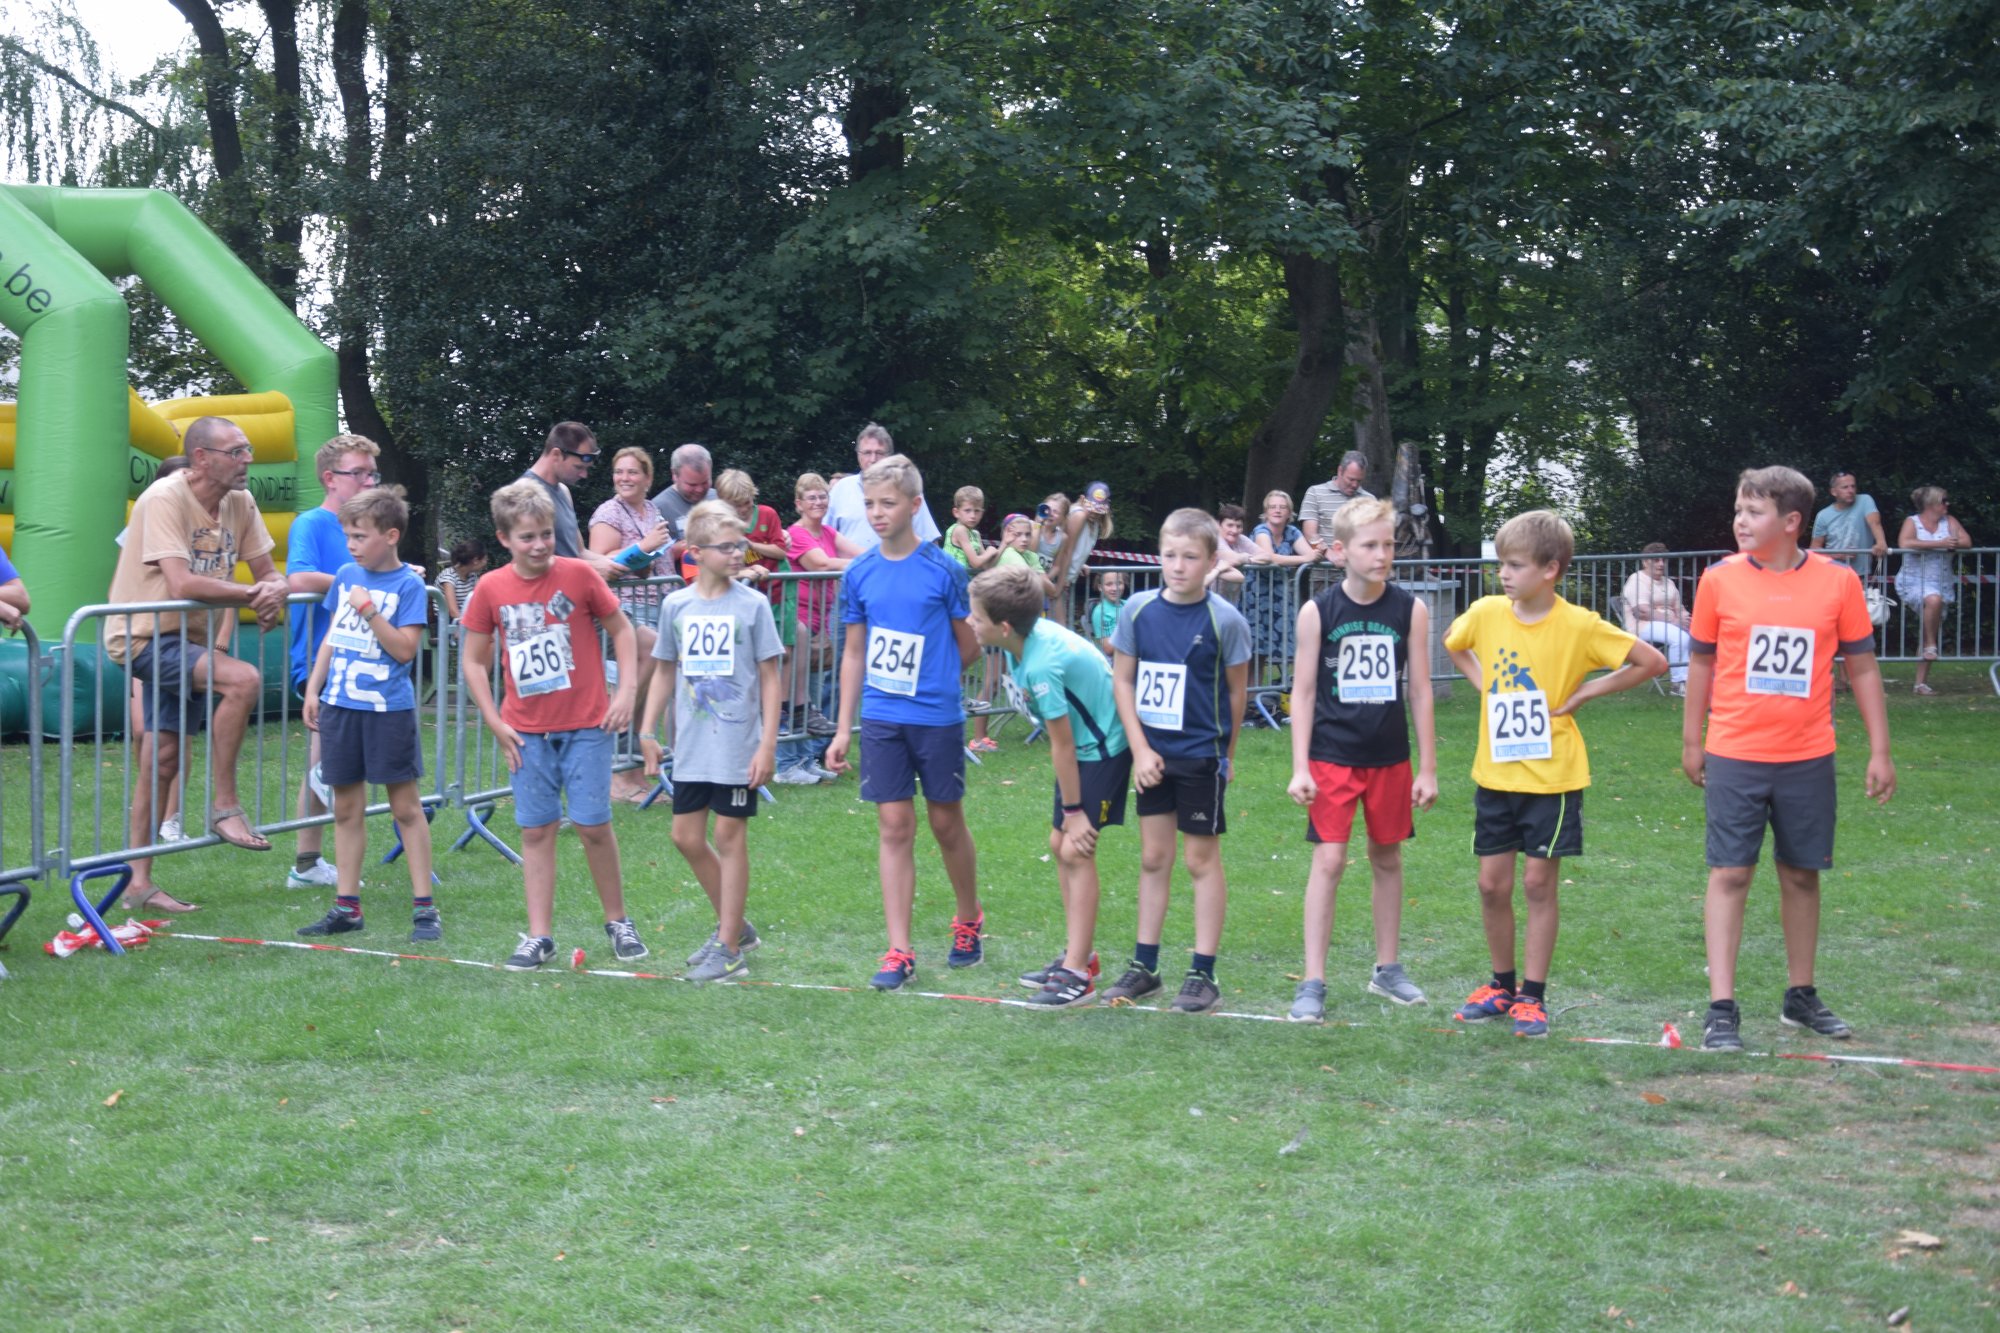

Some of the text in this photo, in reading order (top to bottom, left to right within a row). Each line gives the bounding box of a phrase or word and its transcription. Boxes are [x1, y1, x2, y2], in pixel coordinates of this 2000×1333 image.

[687, 621, 731, 656] 262
[870, 635, 917, 676] 254
[1751, 633, 1809, 676] 252
[515, 639, 561, 682] 256
[1342, 642, 1391, 681] 258
[1140, 670, 1181, 709] 257
[1494, 698, 1546, 740] 255
[730, 787, 748, 807] 10
